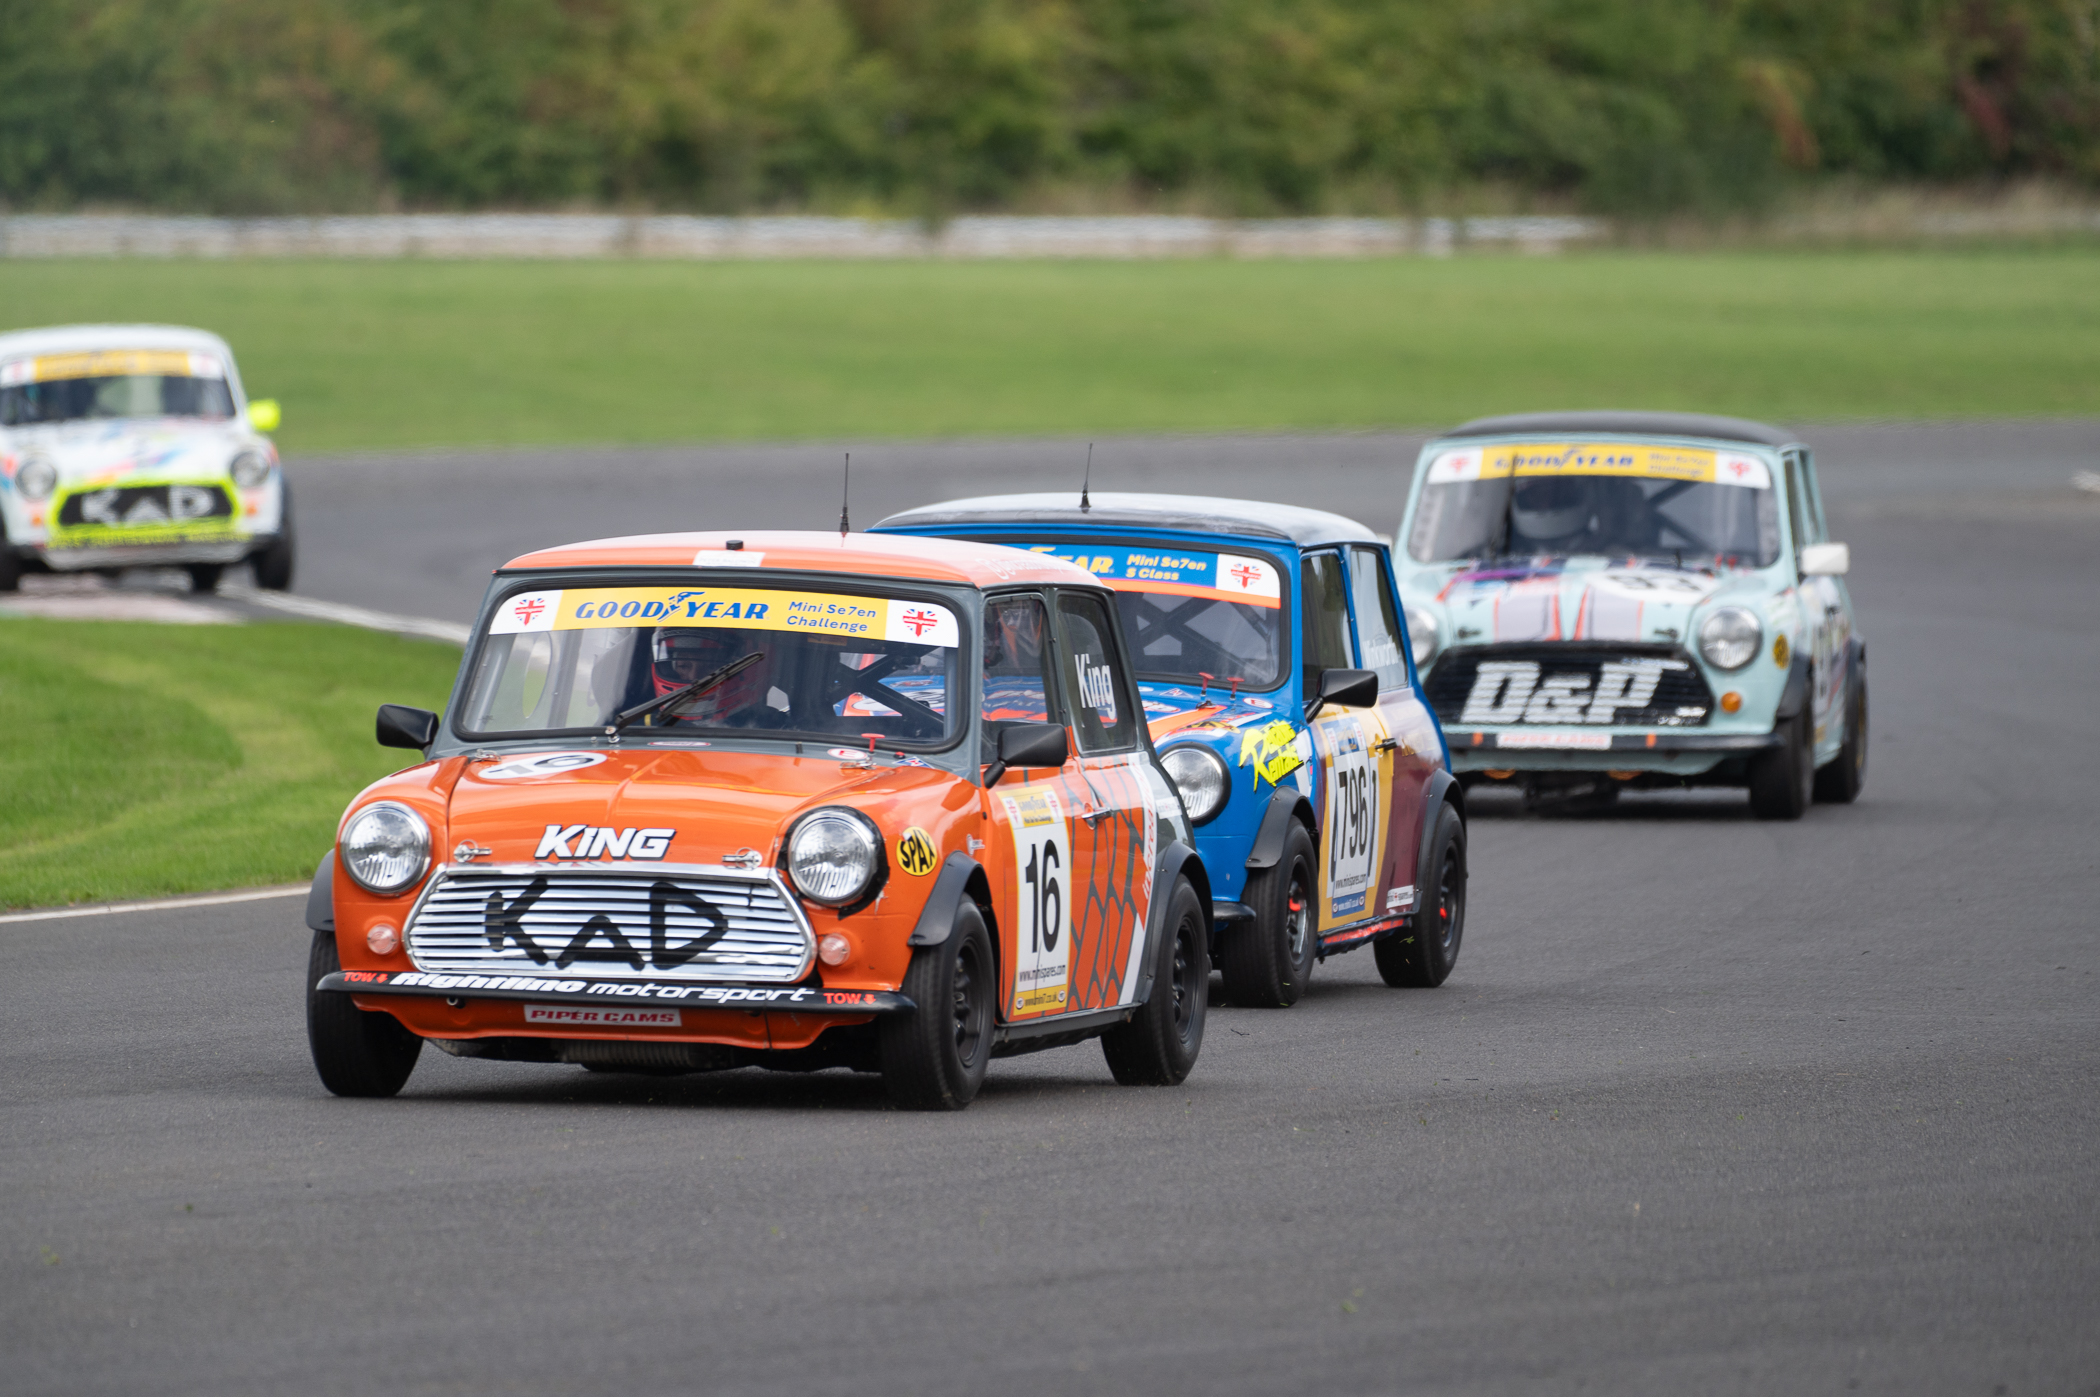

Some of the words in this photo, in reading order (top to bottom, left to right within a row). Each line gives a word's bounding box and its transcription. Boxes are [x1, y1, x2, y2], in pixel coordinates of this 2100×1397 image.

[80, 486, 215, 526] KAD
[1126, 554, 1159, 567] Mini
[1160, 556, 1207, 571] Se7en
[1126, 568, 1137, 577] S
[1139, 569, 1179, 580] Class
[788, 601, 823, 613] Mini
[826, 604, 877, 618] Se7en
[787, 615, 868, 633] Challenge
[1074, 653, 1117, 720] King
[1460, 660, 1664, 724] D&P
[488, 754, 595, 775] 16
[1338, 765, 1368, 860] 796
[534, 824, 676, 861] KING
[900, 826, 936, 875] SPAX
[1025, 838, 1060, 954] 16
[485, 877, 728, 970] KAD
[344, 972, 376, 983] TOW
[587, 983, 815, 1003] motorsport
[823, 993, 862, 1004] TOW
[530, 1009, 598, 1022] PIPER
[604, 1011, 674, 1023] CAMS
